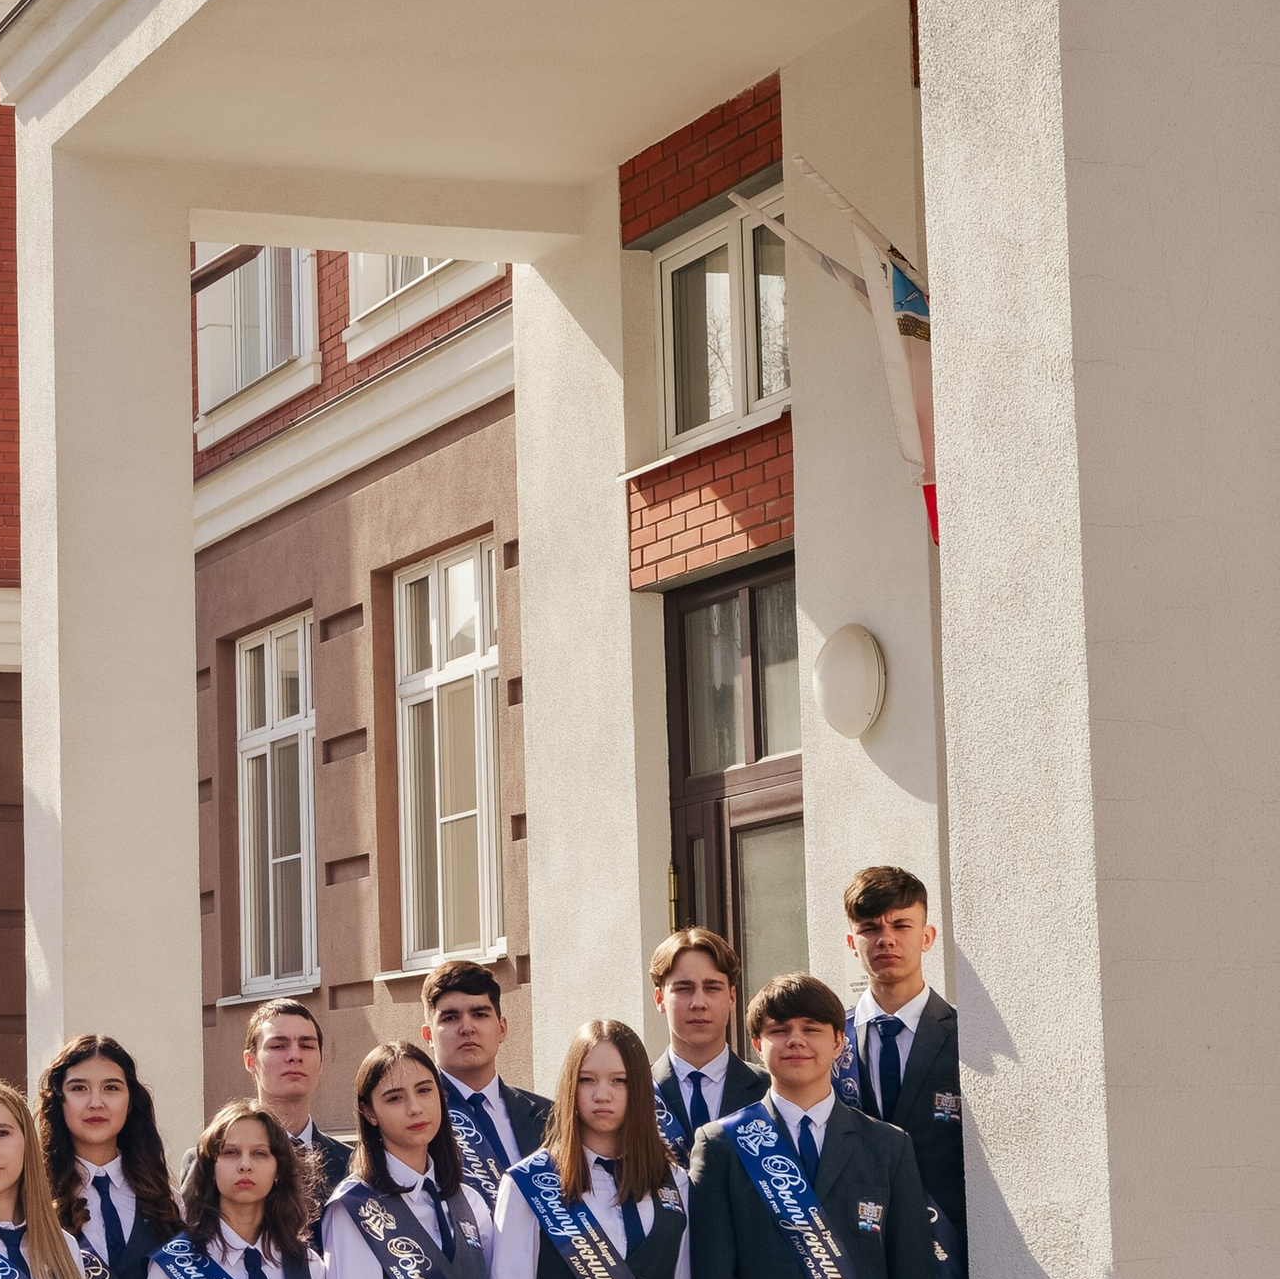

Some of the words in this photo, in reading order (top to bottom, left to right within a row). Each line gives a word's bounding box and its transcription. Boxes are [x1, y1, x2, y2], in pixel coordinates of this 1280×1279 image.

[530, 1196, 547, 1214] 2025
[542, 1215, 554, 1227] год
[758, 1180, 774, 1199] 2025
[769, 1200, 781, 1213] год
[569, 1256, 588, 1275] ГАОУ
[790, 1235, 808, 1256] ГАОУ
[804, 1257, 815, 1268] СО
